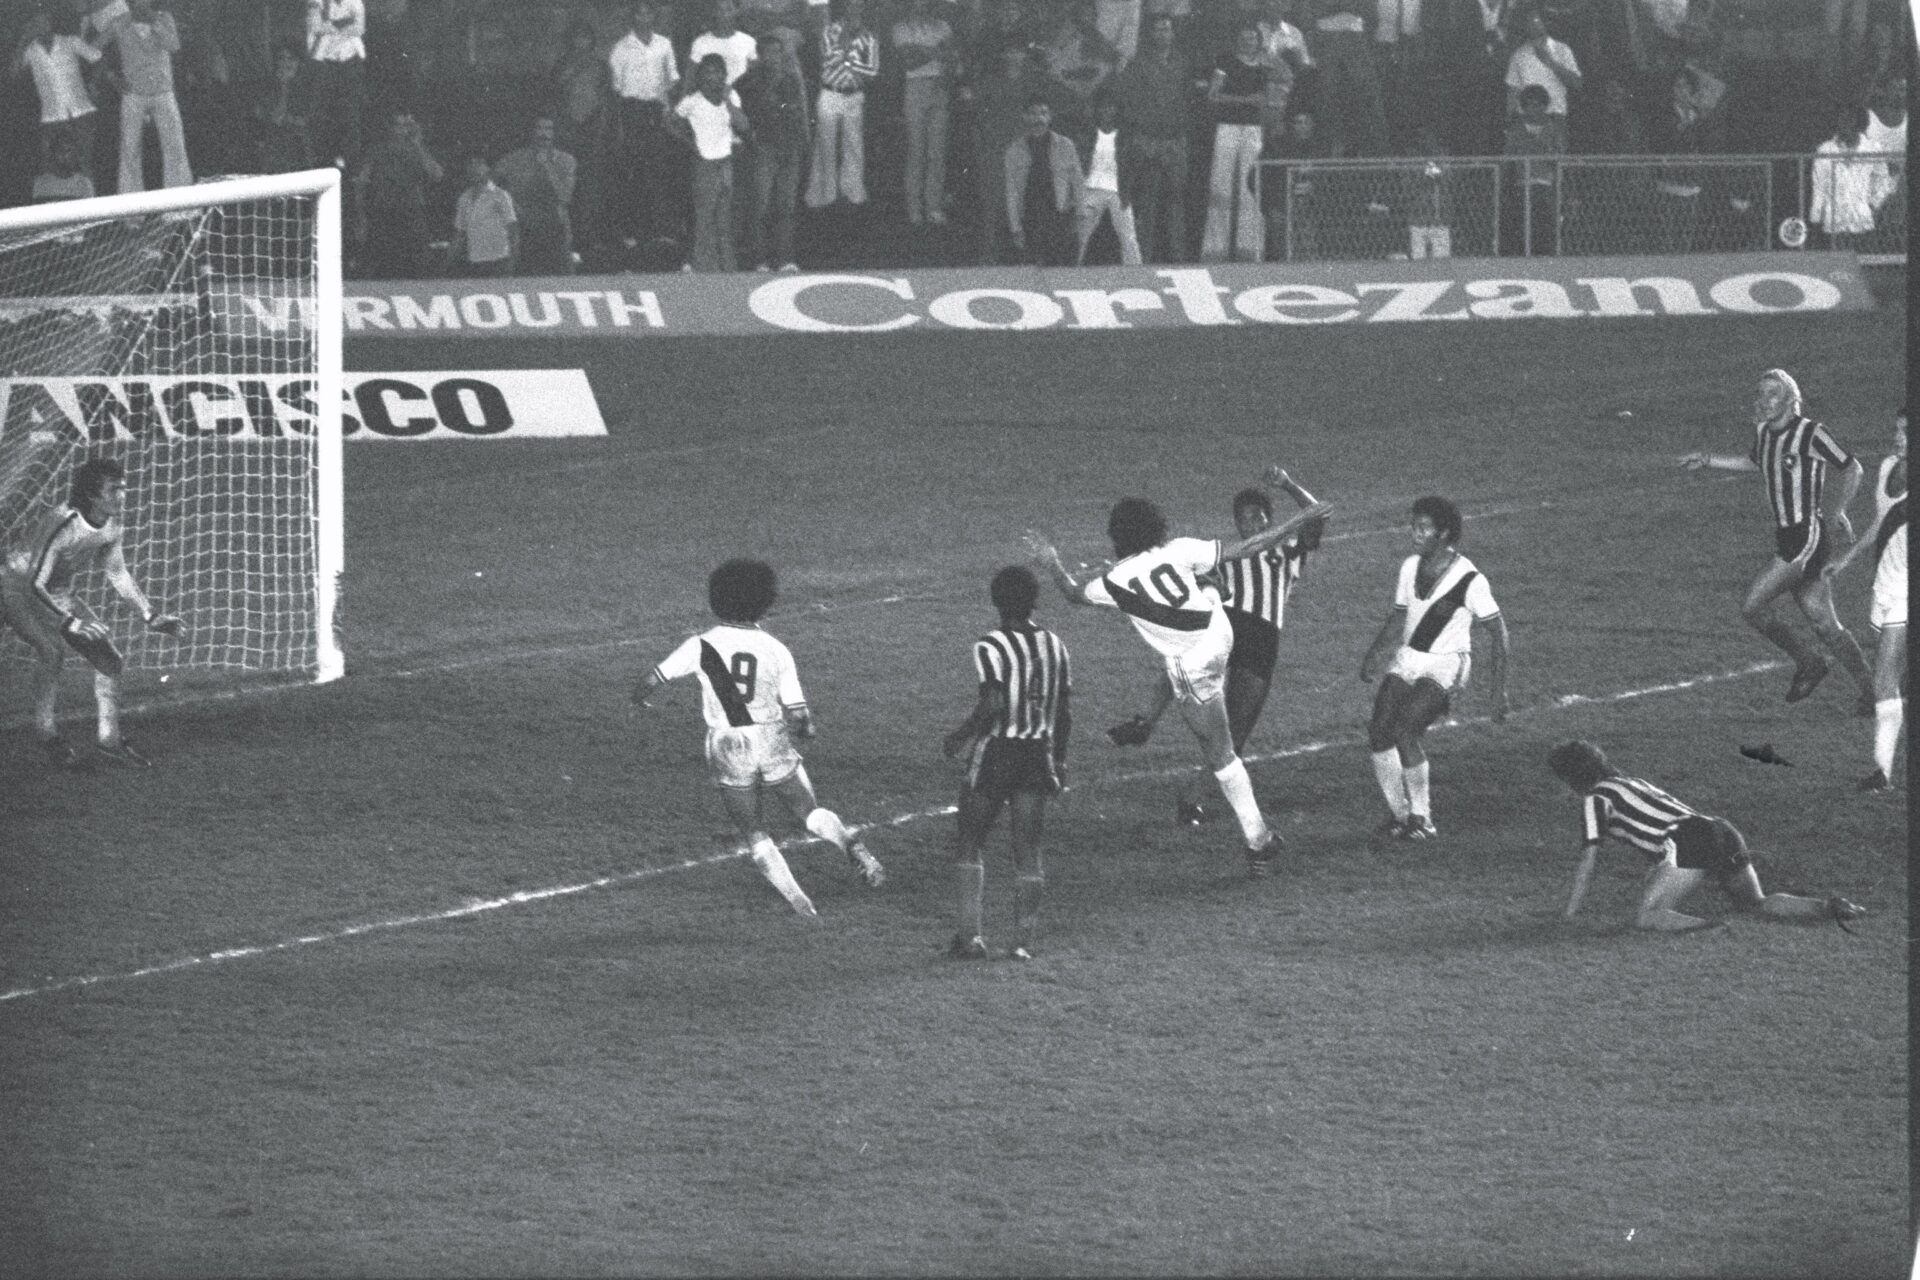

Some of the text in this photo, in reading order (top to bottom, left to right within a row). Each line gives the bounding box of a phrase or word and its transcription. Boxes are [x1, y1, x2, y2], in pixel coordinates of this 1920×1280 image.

[748, 267, 1842, 332] Cortezano
[1127, 562, 1190, 609] 10
[731, 651, 757, 704] 9
